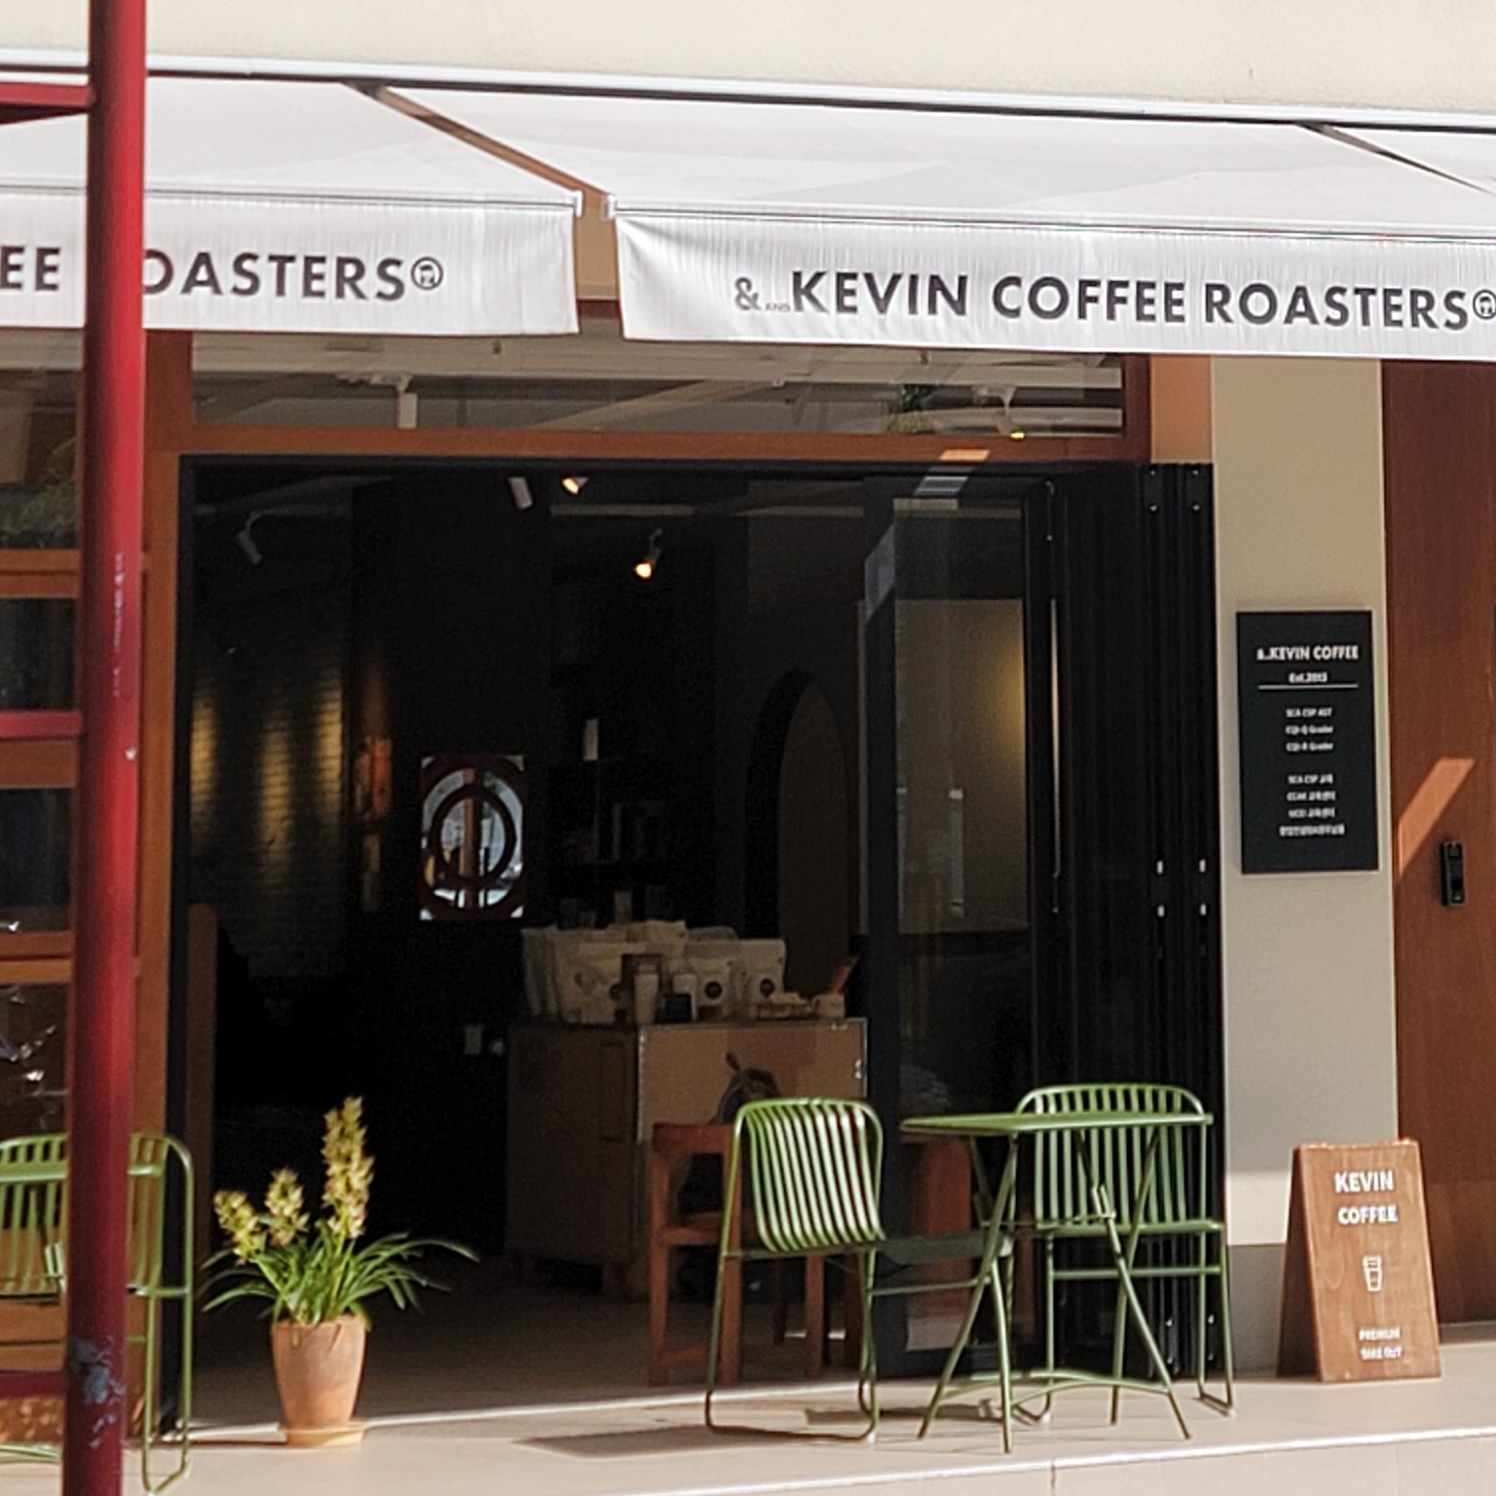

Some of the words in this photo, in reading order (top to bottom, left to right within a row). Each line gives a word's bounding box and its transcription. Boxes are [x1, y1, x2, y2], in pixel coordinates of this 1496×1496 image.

[142, 248, 405, 301] OASTERS
[792, 270, 968, 316] KEVIN
[992, 275, 1185, 323] COFFEE
[1205, 282, 1468, 331] ROASTERS
[1334, 1170, 1394, 1193] KEVIN
[1338, 1204, 1398, 1225] COFFEE
